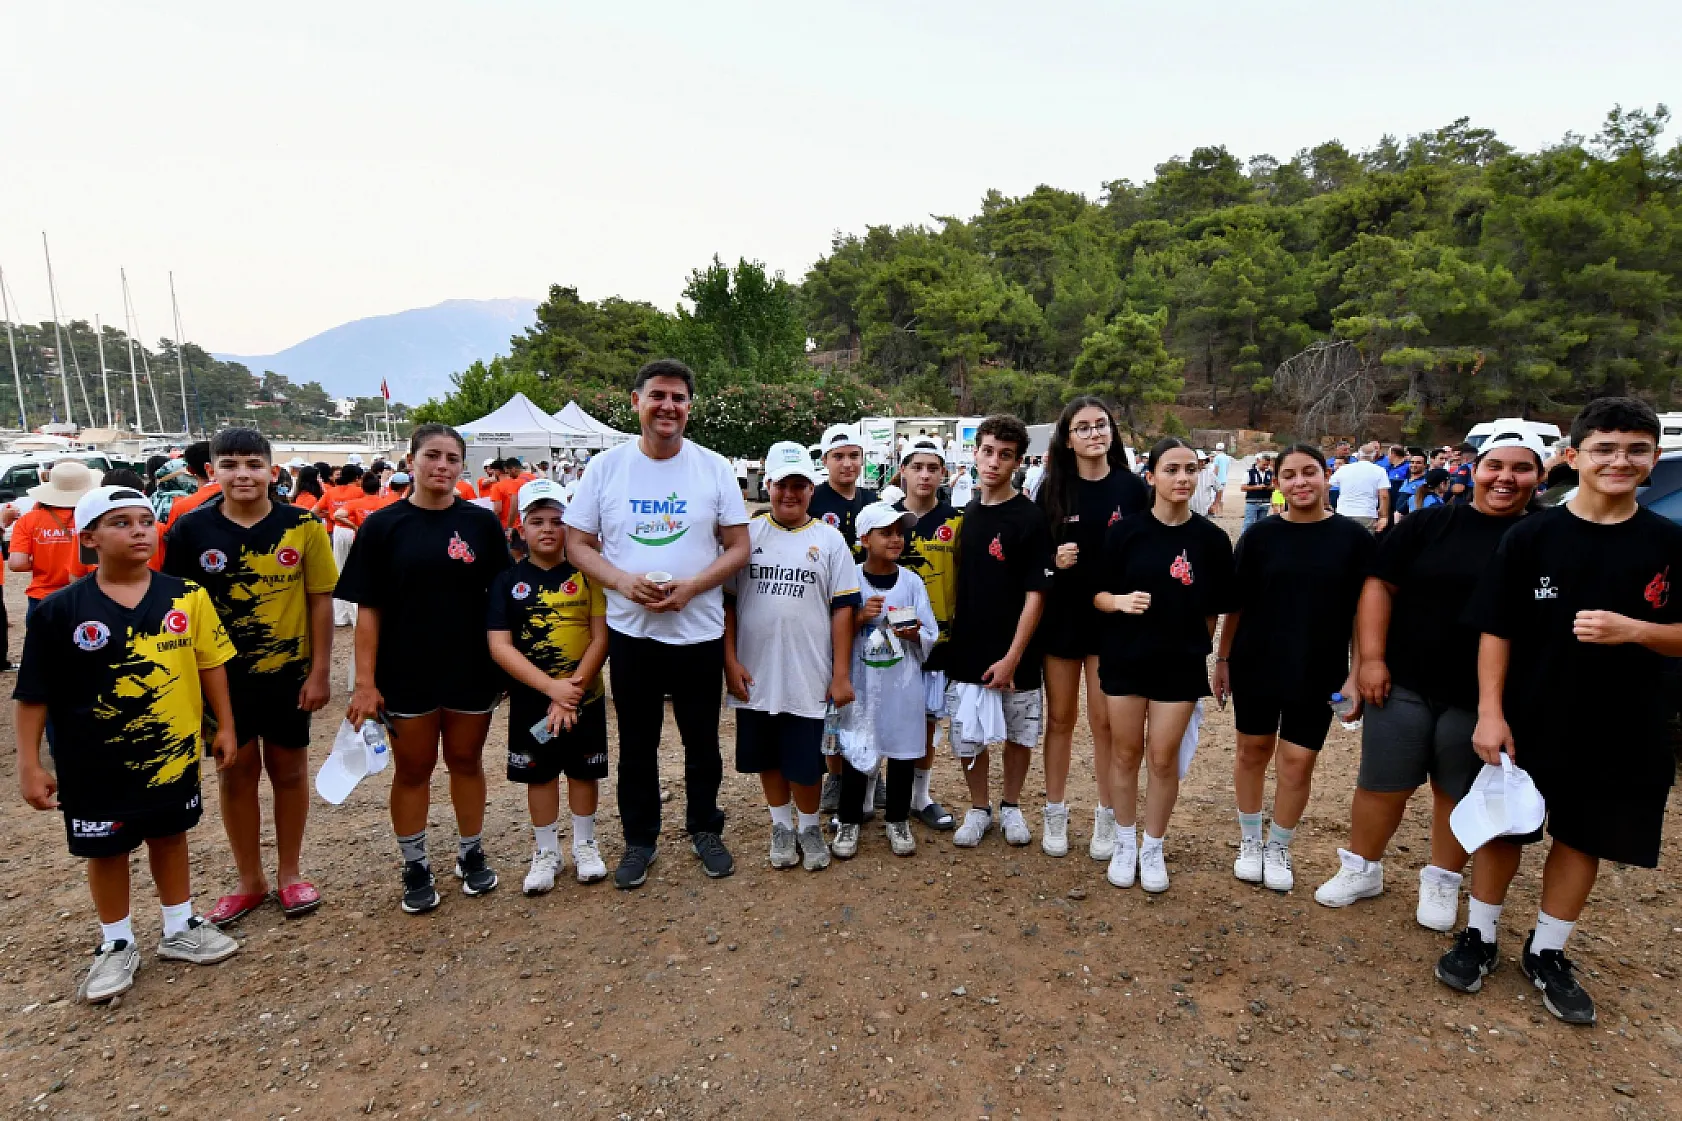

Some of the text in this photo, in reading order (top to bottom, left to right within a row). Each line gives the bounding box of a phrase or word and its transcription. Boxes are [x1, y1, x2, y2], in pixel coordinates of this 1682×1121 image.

[749, 563, 817, 584] Emirates
[757, 581, 805, 598] FLY BETTER
